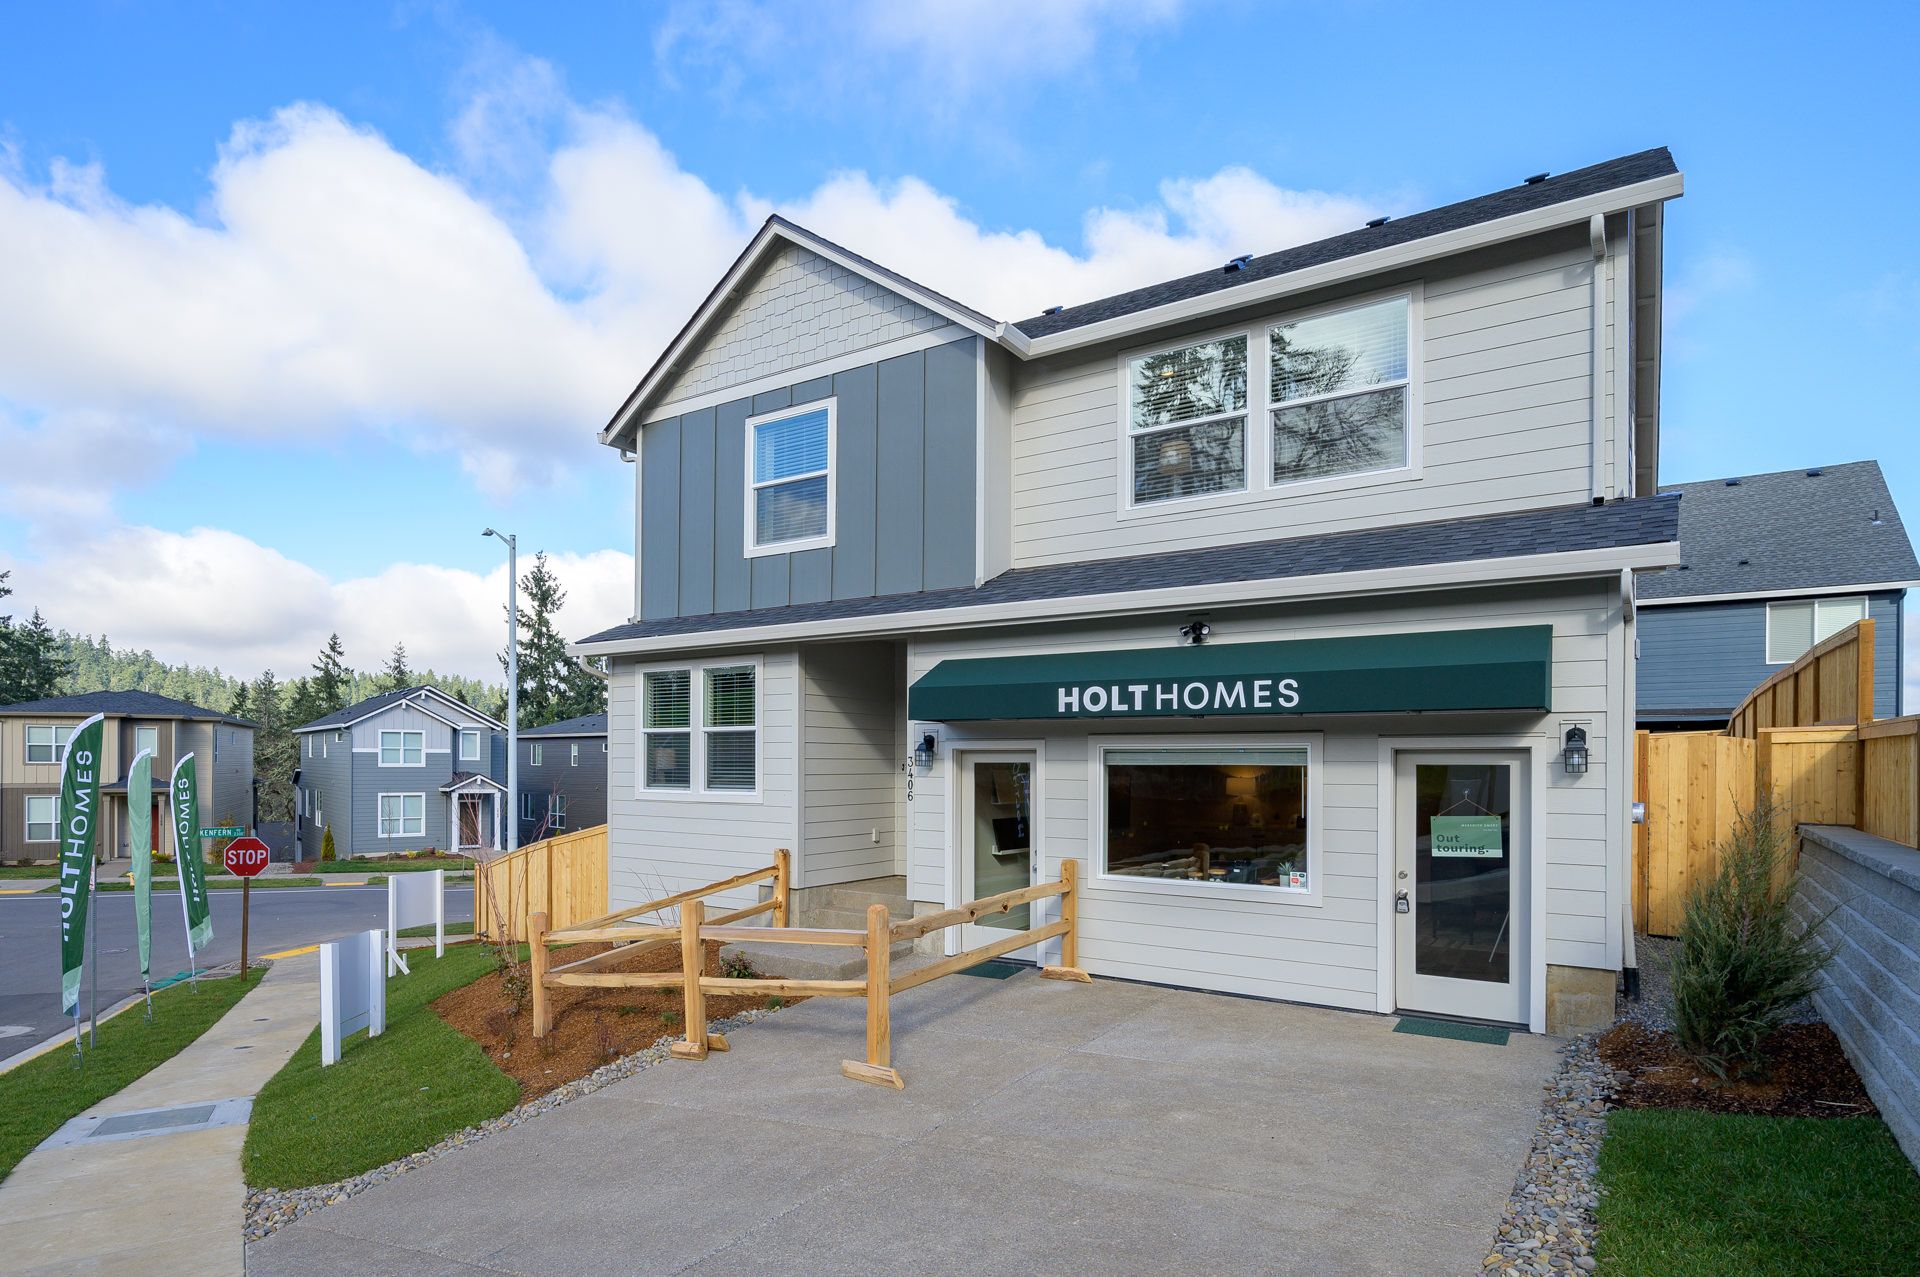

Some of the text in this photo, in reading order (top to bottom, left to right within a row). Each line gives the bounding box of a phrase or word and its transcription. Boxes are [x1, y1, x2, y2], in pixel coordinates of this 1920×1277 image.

[200, 829, 232, 837] KENFERN
[1436, 834, 1461, 843] Out
[1436, 844, 1489, 855] touring.
[227, 850, 267, 865] STOP
